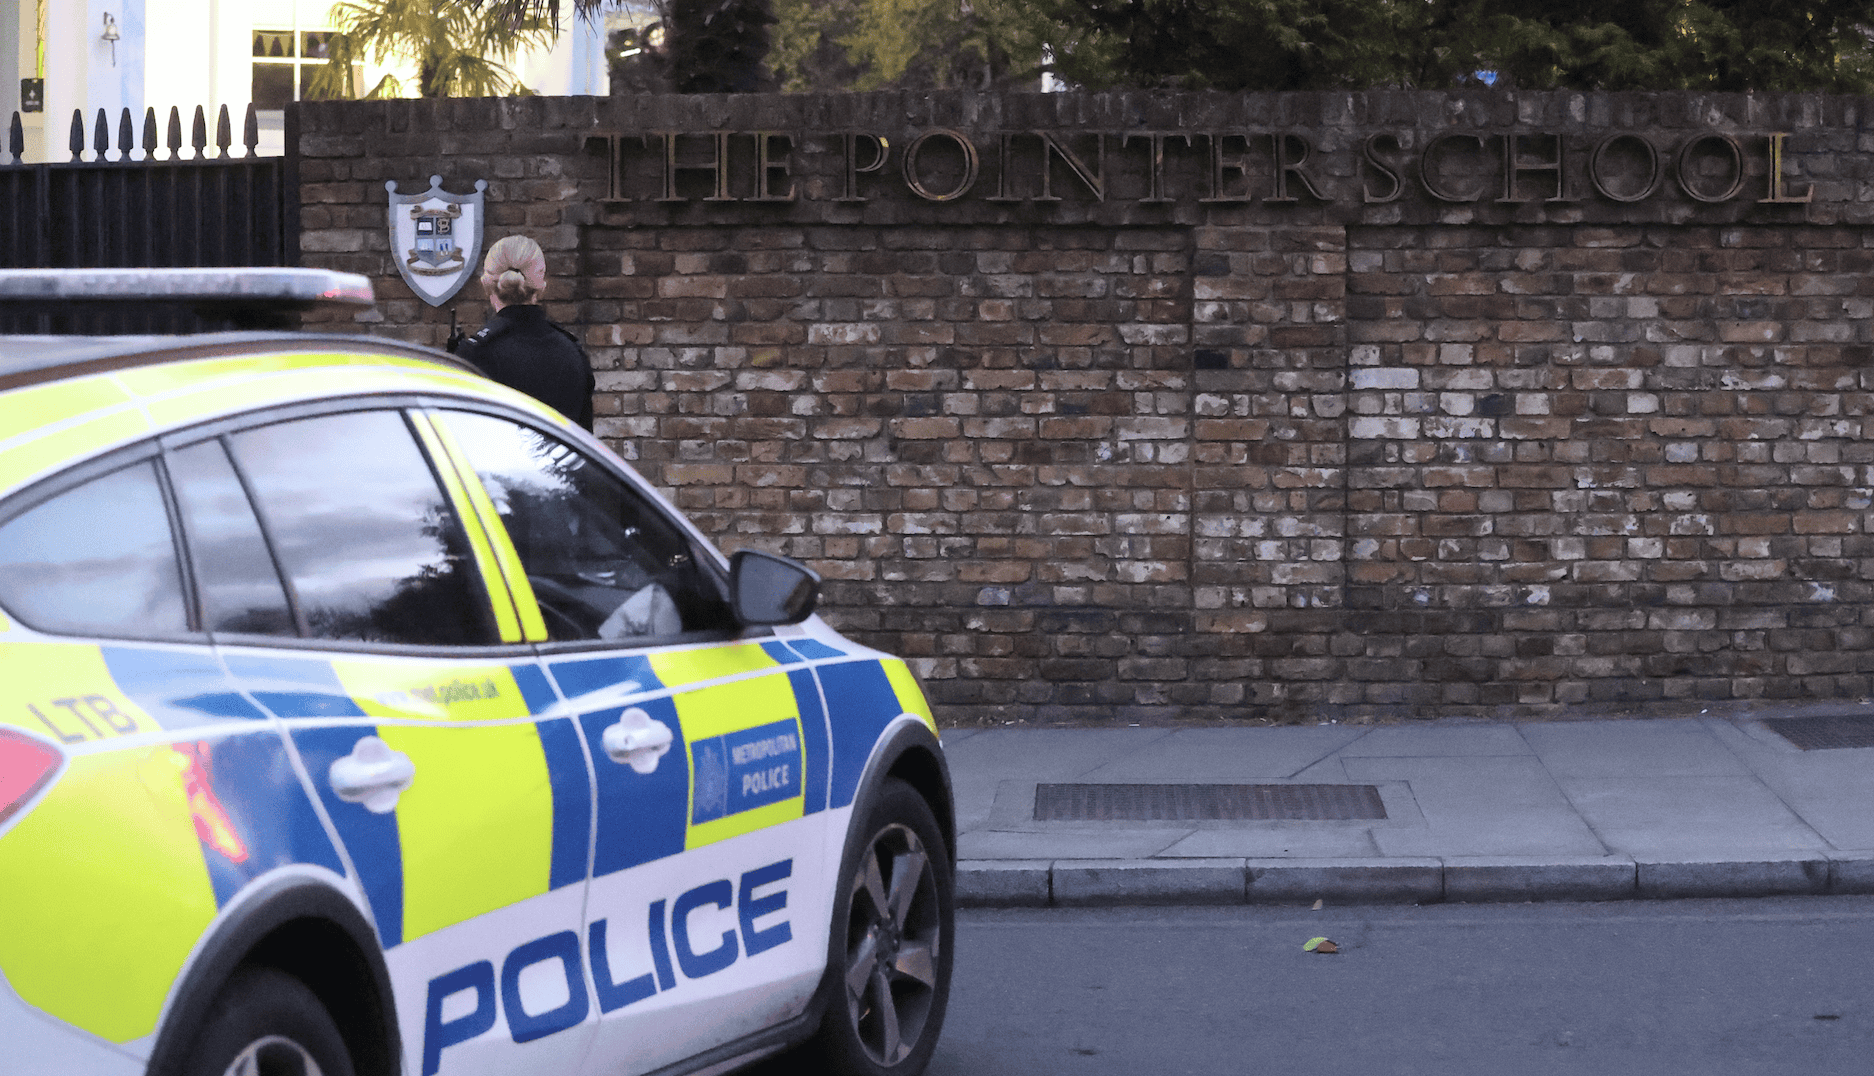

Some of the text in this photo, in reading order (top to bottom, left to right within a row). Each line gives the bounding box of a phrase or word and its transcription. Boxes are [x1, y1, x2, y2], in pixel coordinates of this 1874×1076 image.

[581, 127, 1815, 204] THE POINTER SCHOOL
[26, 693, 139, 745] LTB
[742, 764, 790, 797] POLICE
[422, 857, 793, 1076] POLICE
